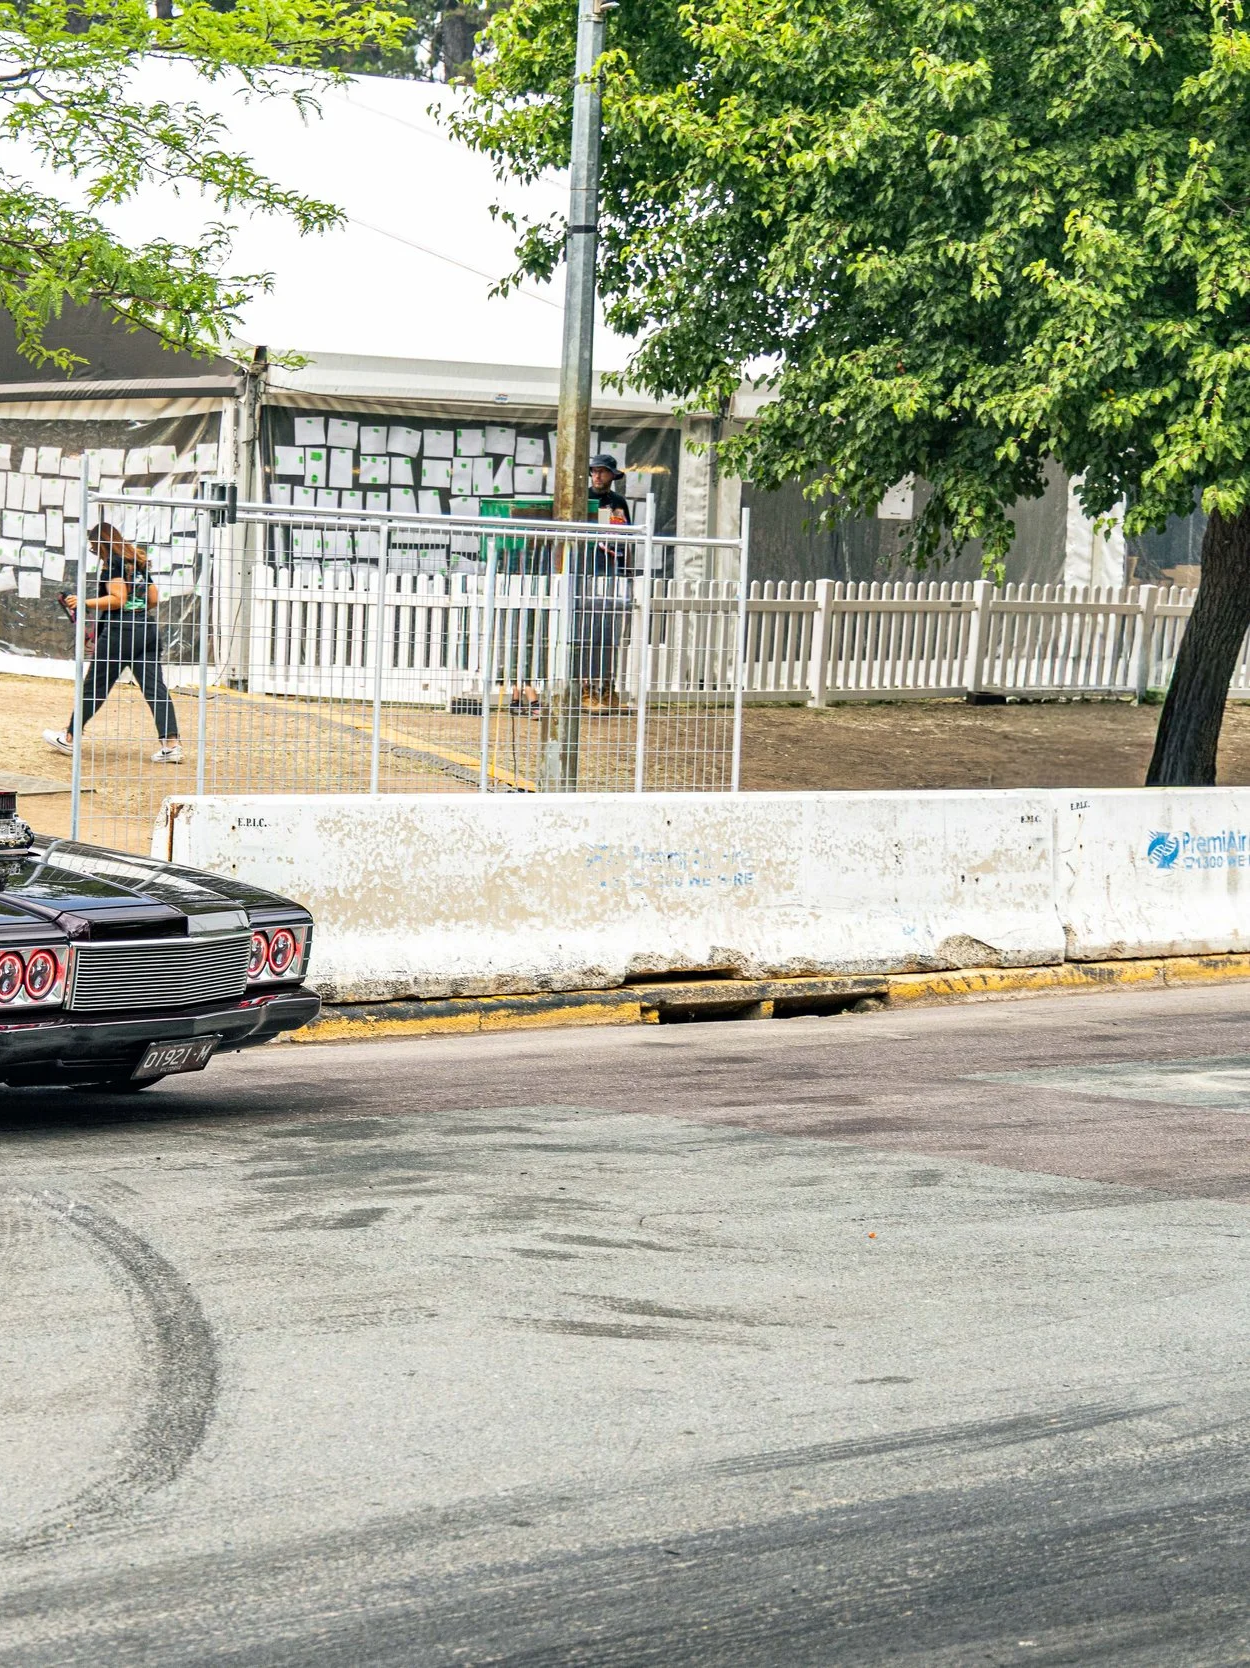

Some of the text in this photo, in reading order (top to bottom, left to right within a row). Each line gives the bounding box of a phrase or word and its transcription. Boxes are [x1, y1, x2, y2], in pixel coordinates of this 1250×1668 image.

[237, 817, 268, 828] E.P.I.C.
[1182, 830, 1247, 853] PremiAir
[1196, 855, 1224, 869] 1300
